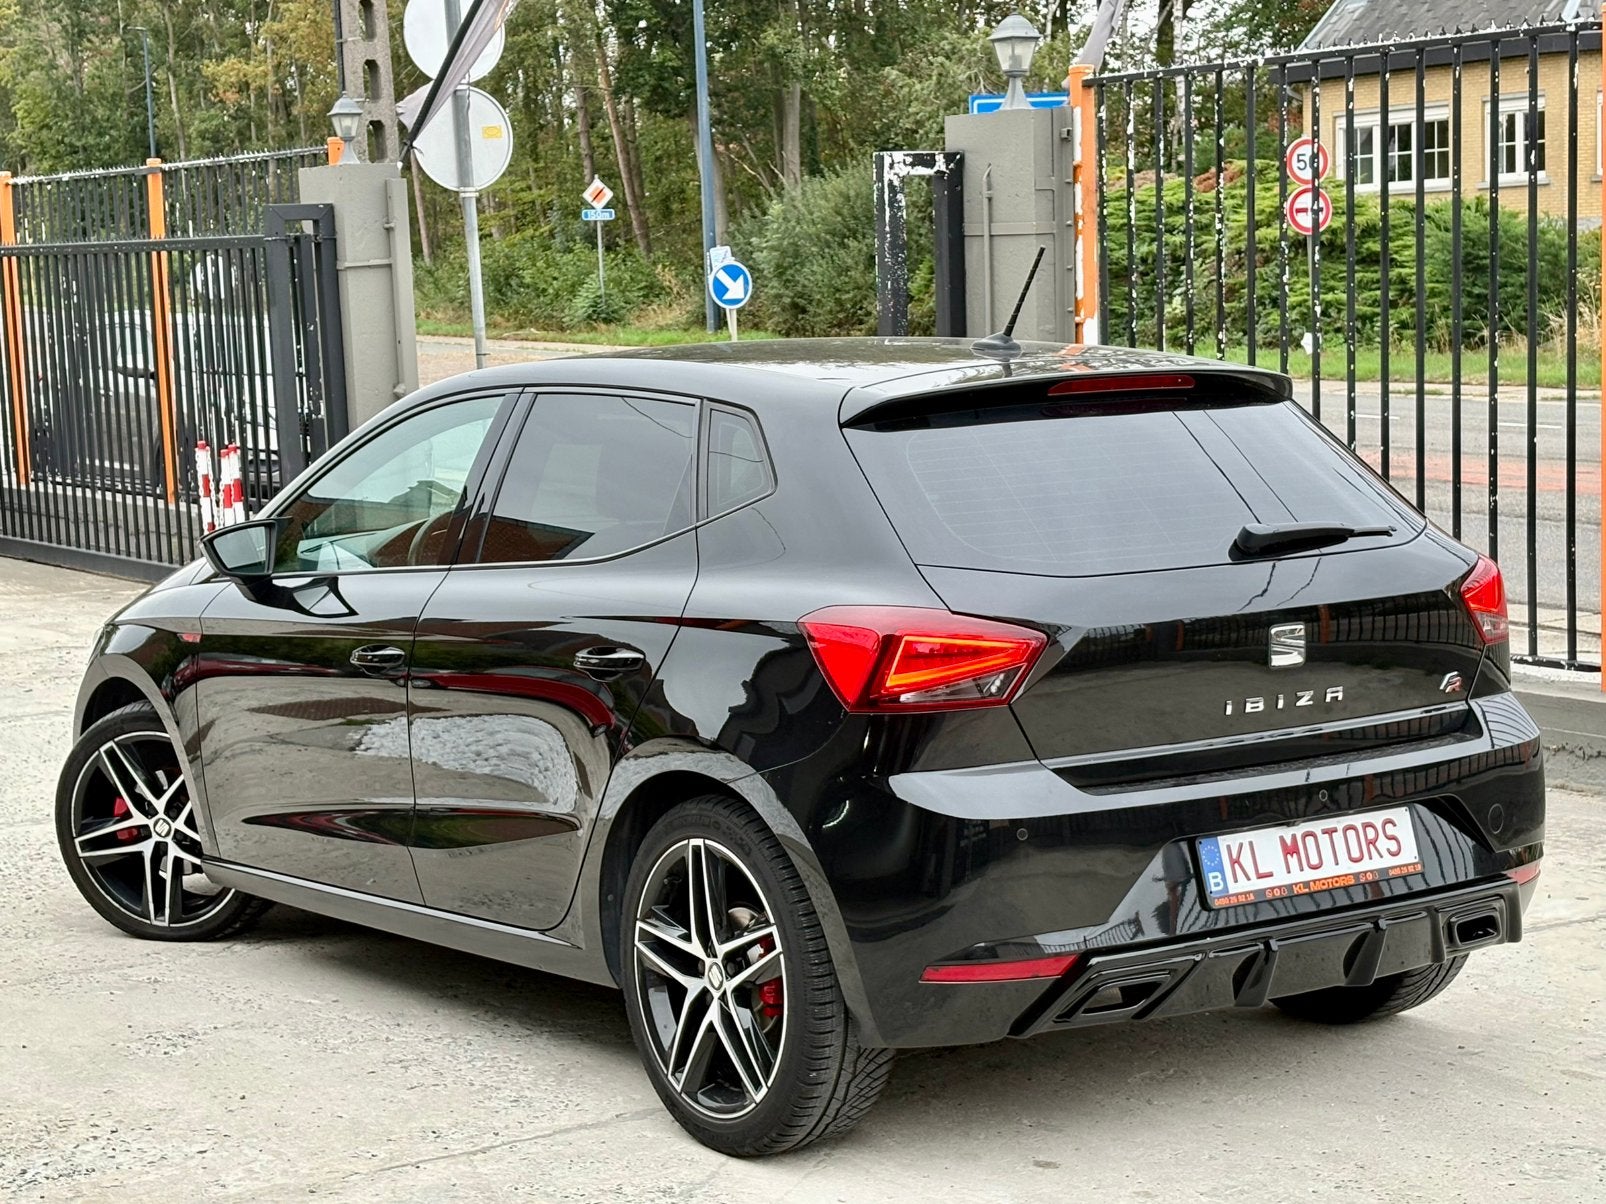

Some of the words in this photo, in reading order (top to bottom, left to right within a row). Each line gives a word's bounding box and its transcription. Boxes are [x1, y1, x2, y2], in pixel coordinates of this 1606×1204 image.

[1224, 685, 1344, 716] IBIZA
[1226, 840, 1274, 884] KL
[1278, 817, 1402, 874] MOTORS
[1207, 871, 1224, 892] B
[1292, 882, 1309, 895] KL
[1309, 874, 1355, 891] MOTORS
